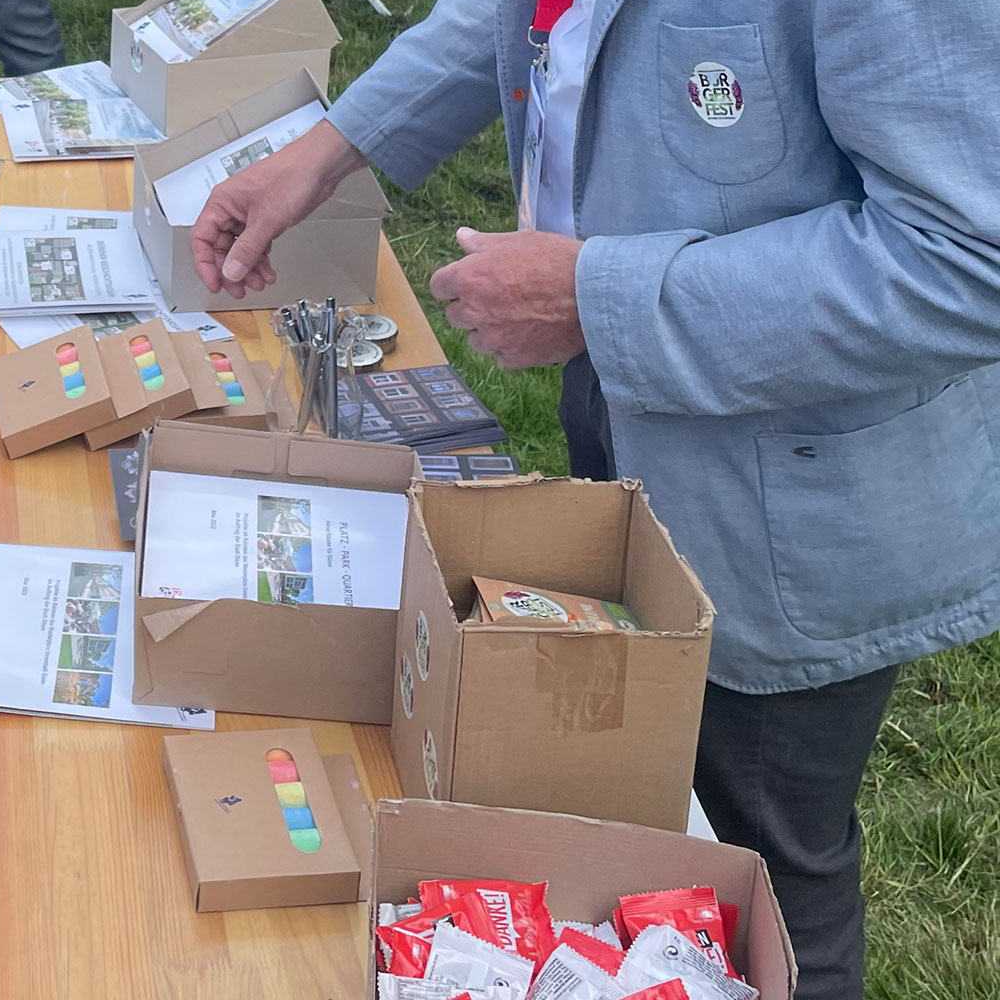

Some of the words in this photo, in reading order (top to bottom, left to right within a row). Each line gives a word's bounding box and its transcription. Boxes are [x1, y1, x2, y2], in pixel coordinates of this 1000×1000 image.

[705, 102, 735, 116] FEST
[339, 521, 349, 545] PLATZ
[341, 550, 351, 569] PARK
[483, 893, 514, 947] DANKE!
